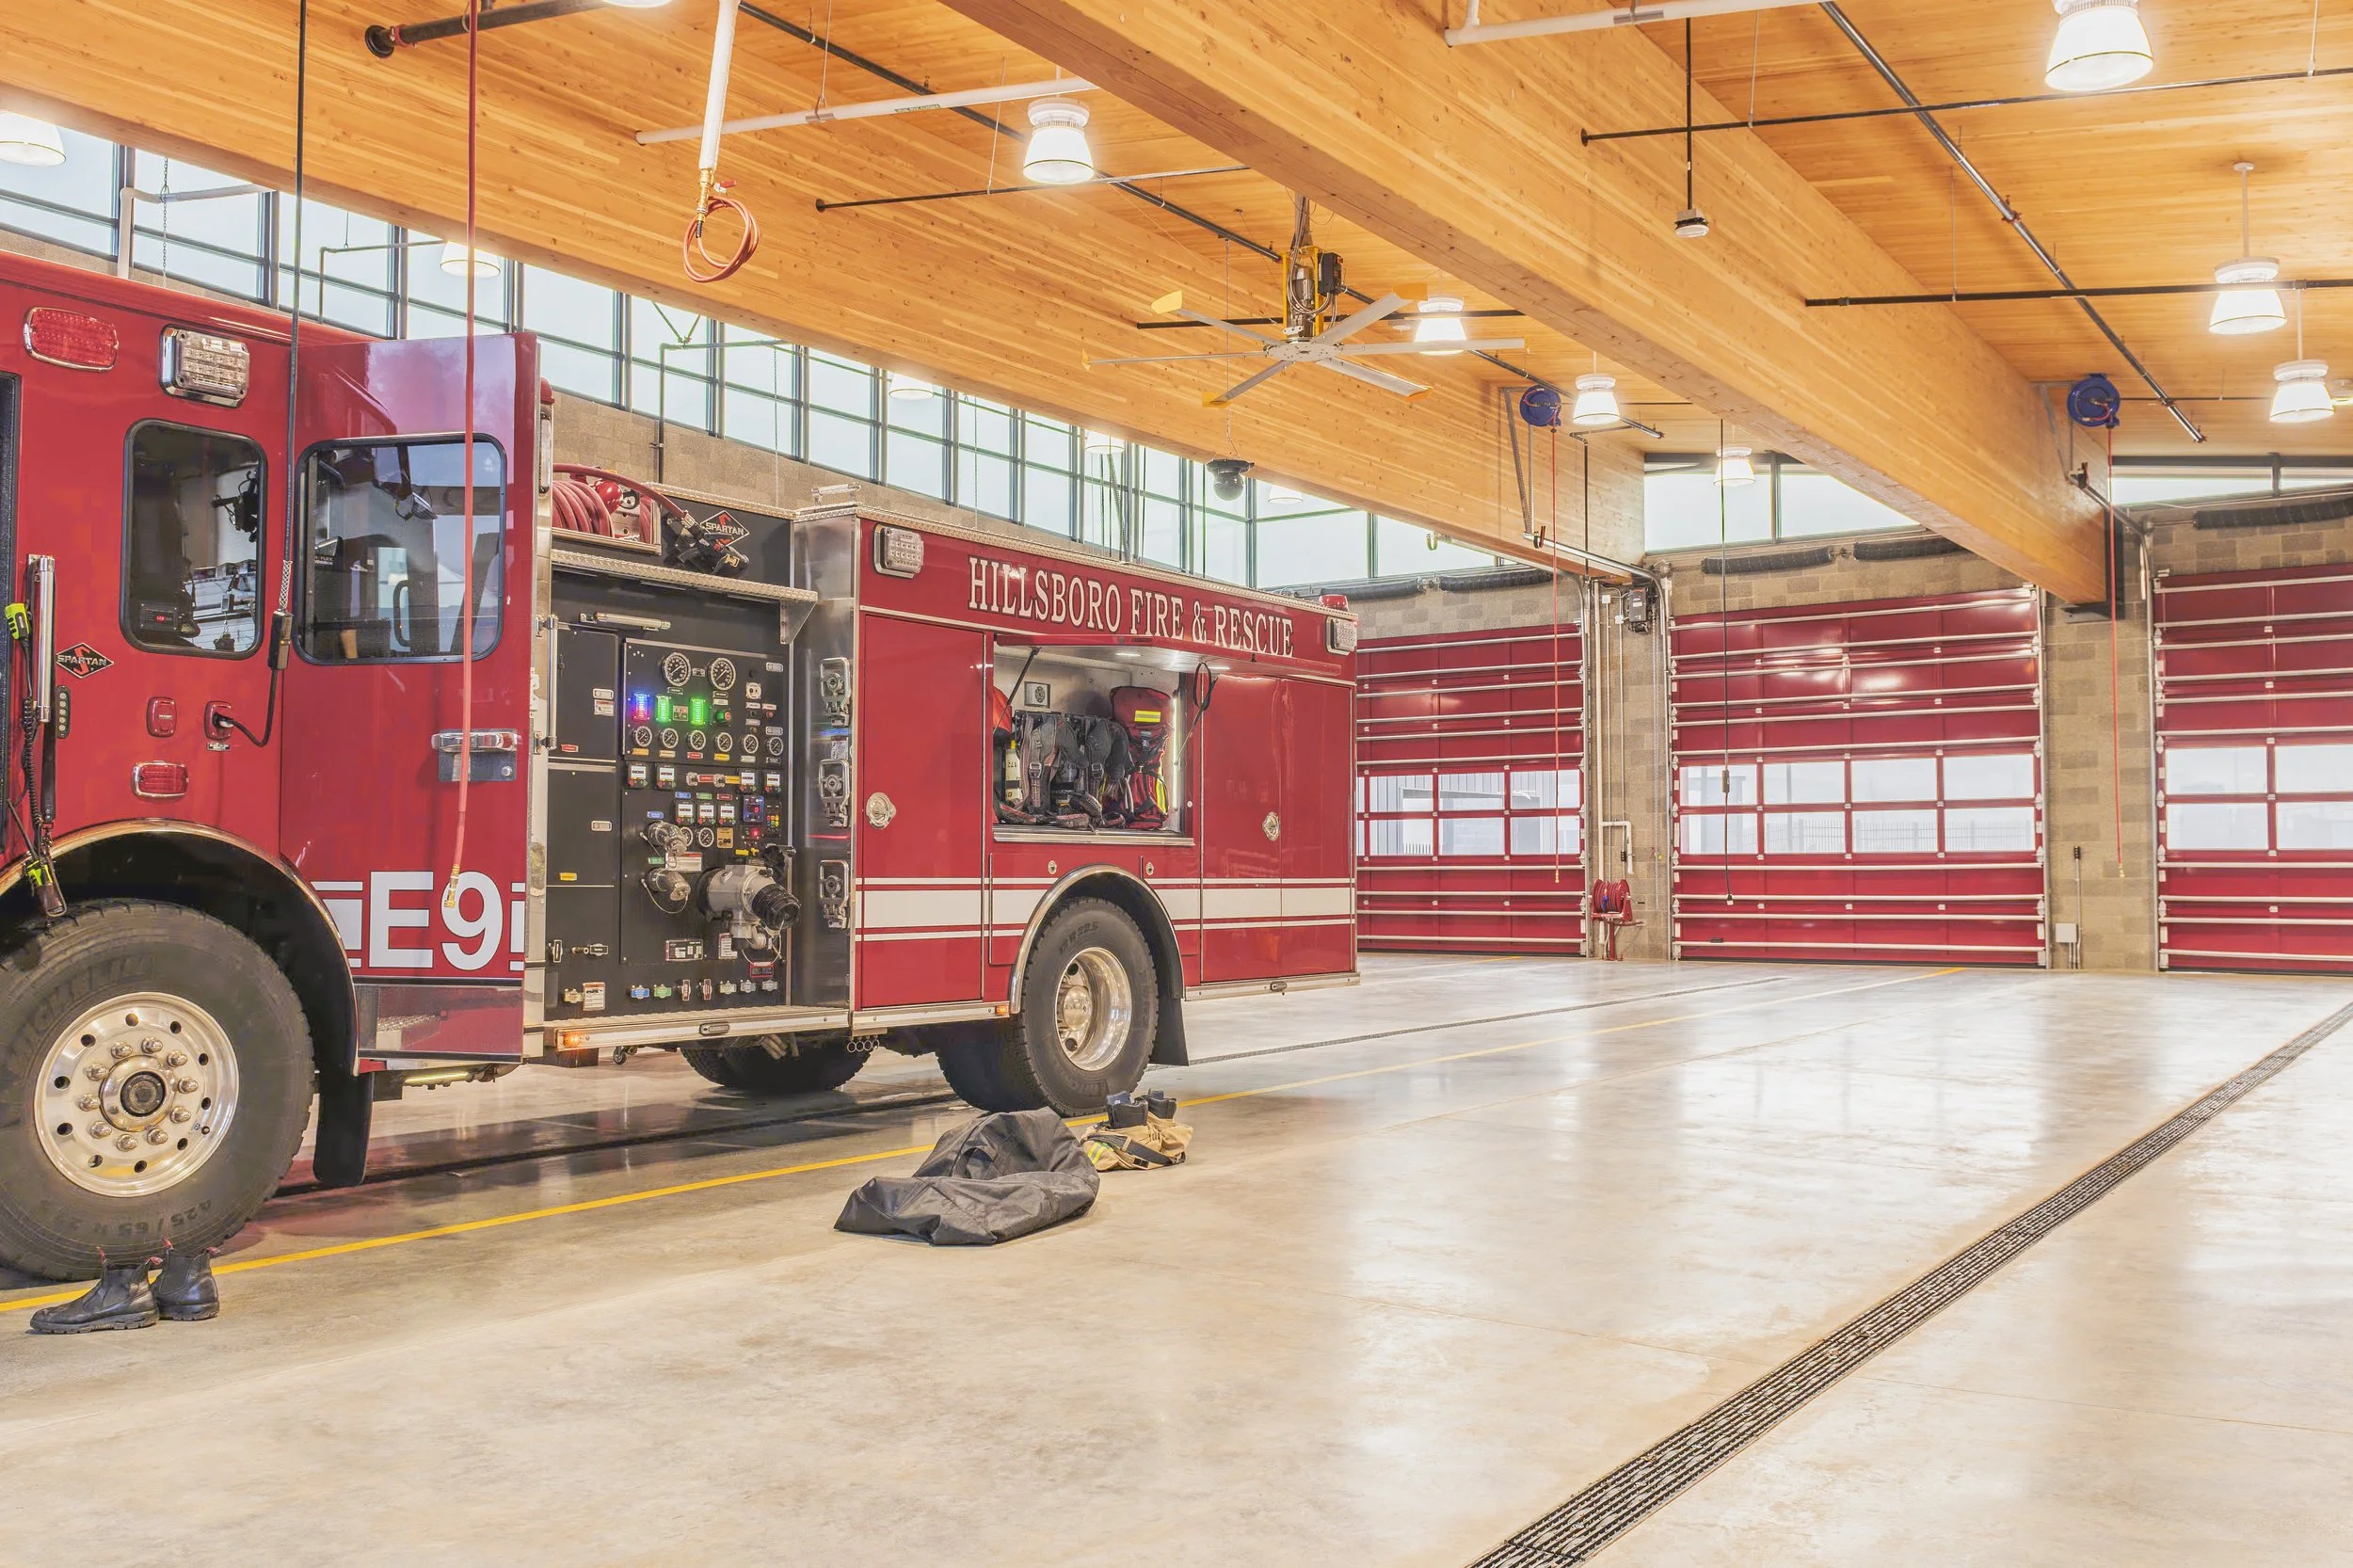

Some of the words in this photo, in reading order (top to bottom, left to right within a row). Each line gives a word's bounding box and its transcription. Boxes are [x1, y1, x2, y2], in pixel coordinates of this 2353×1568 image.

[705, 522, 744, 536] SPARTAN
[968, 556, 1122, 633] HILLSBORO
[1130, 588, 1184, 640] FIRE
[1192, 600, 1208, 644] &
[1213, 604, 1295, 658] RESCUE
[56, 654, 107, 666] SPARTAN
[368, 871, 504, 970] E9
